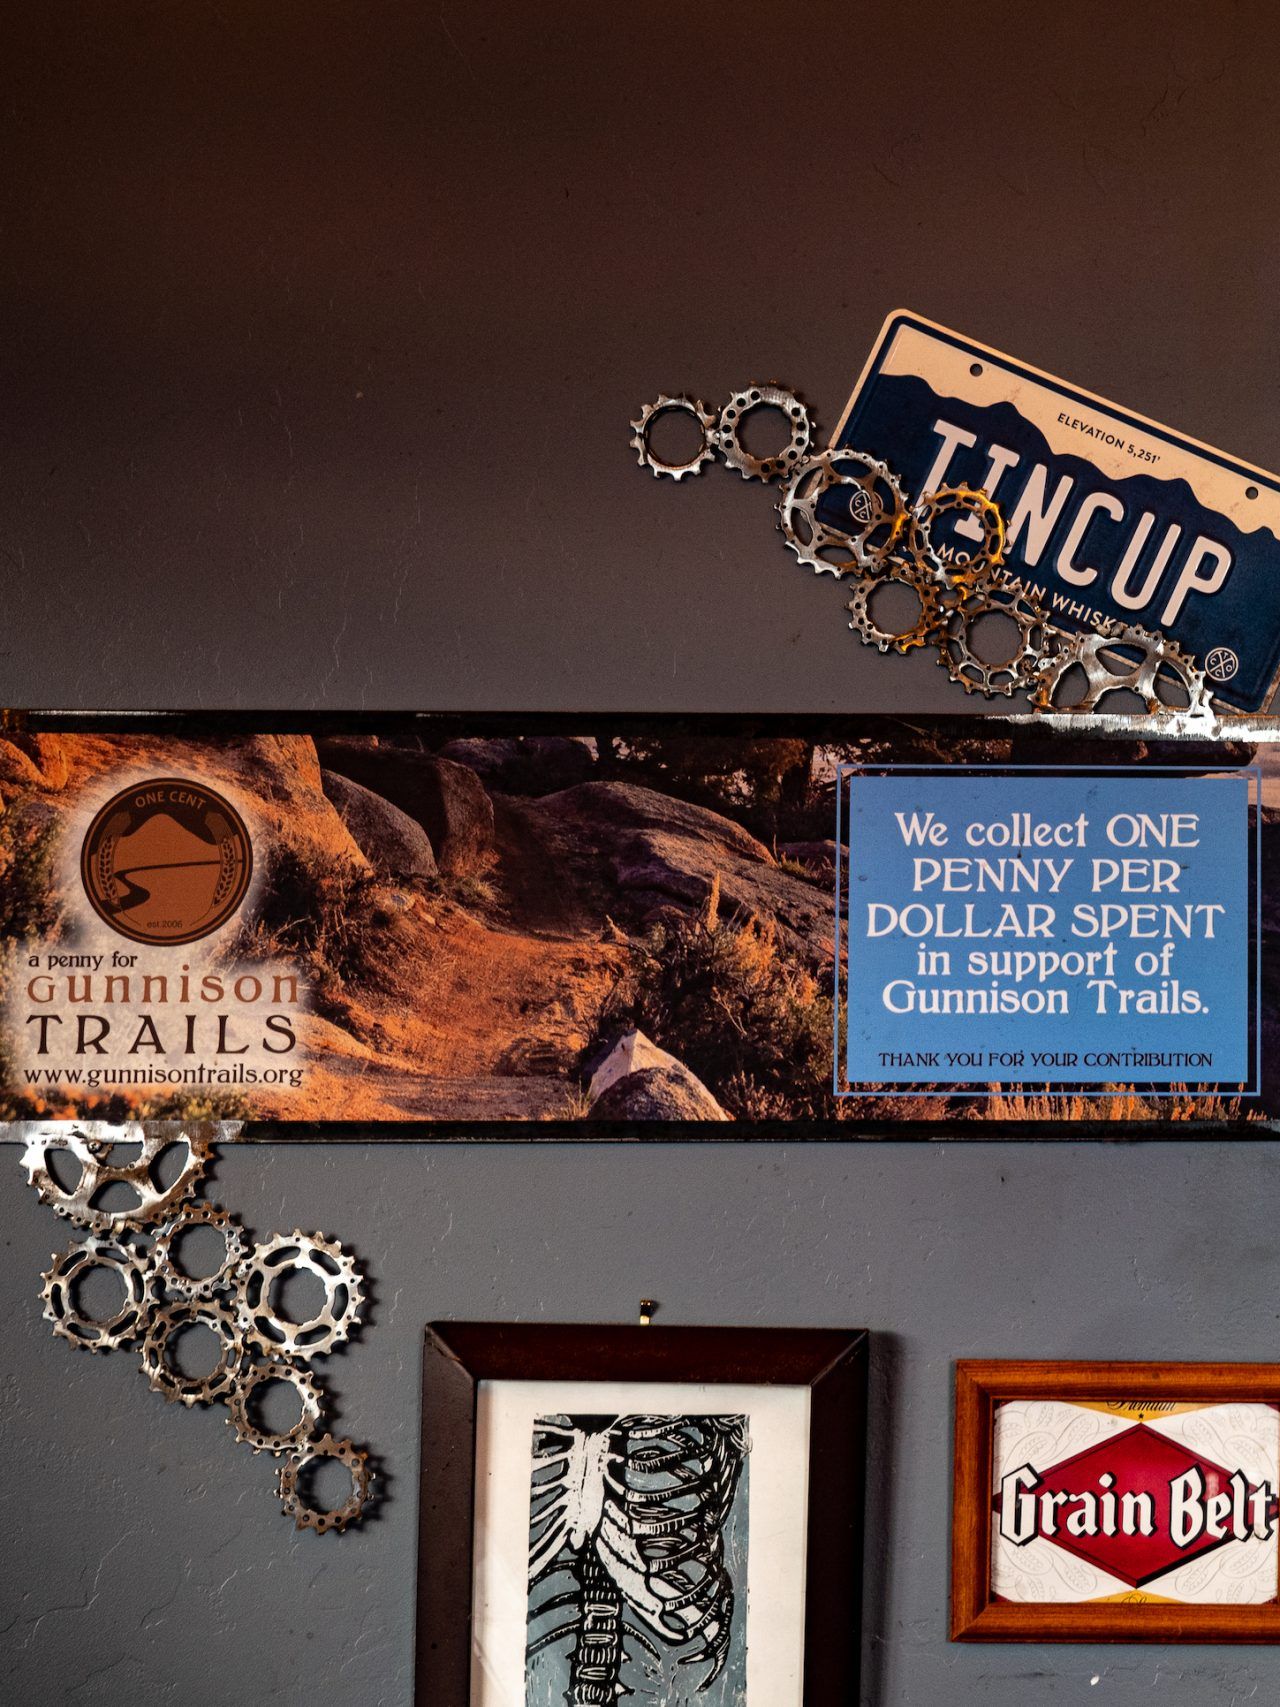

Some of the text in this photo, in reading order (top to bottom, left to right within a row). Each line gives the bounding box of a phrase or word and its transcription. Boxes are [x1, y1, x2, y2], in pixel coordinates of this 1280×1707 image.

[1057, 412, 1126, 450] ELEVATION
[914, 418, 1233, 628] TINCUP
[1051, 592, 1119, 631] WHISK
[135, 790, 207, 810] ONE CENT
[894, 812, 1200, 849] We collect ONE
[912, 858, 1181, 893] PENNY PER
[866, 902, 1226, 939] DOLLAR SPENT
[28, 950, 138, 971] a penny for
[917, 942, 1176, 983] in support of
[26, 963, 299, 1004] Gunnison
[881, 979, 1210, 1016] Gunnison Trails.
[25, 1013, 297, 1055] TRAILS
[23, 1062, 304, 1087] www.gunnisontrails.org
[878, 1051, 1213, 1069] THANK YOU FOR YOUR CONTRIBUTION
[1000, 1461, 1279, 1549] Grain Belt
